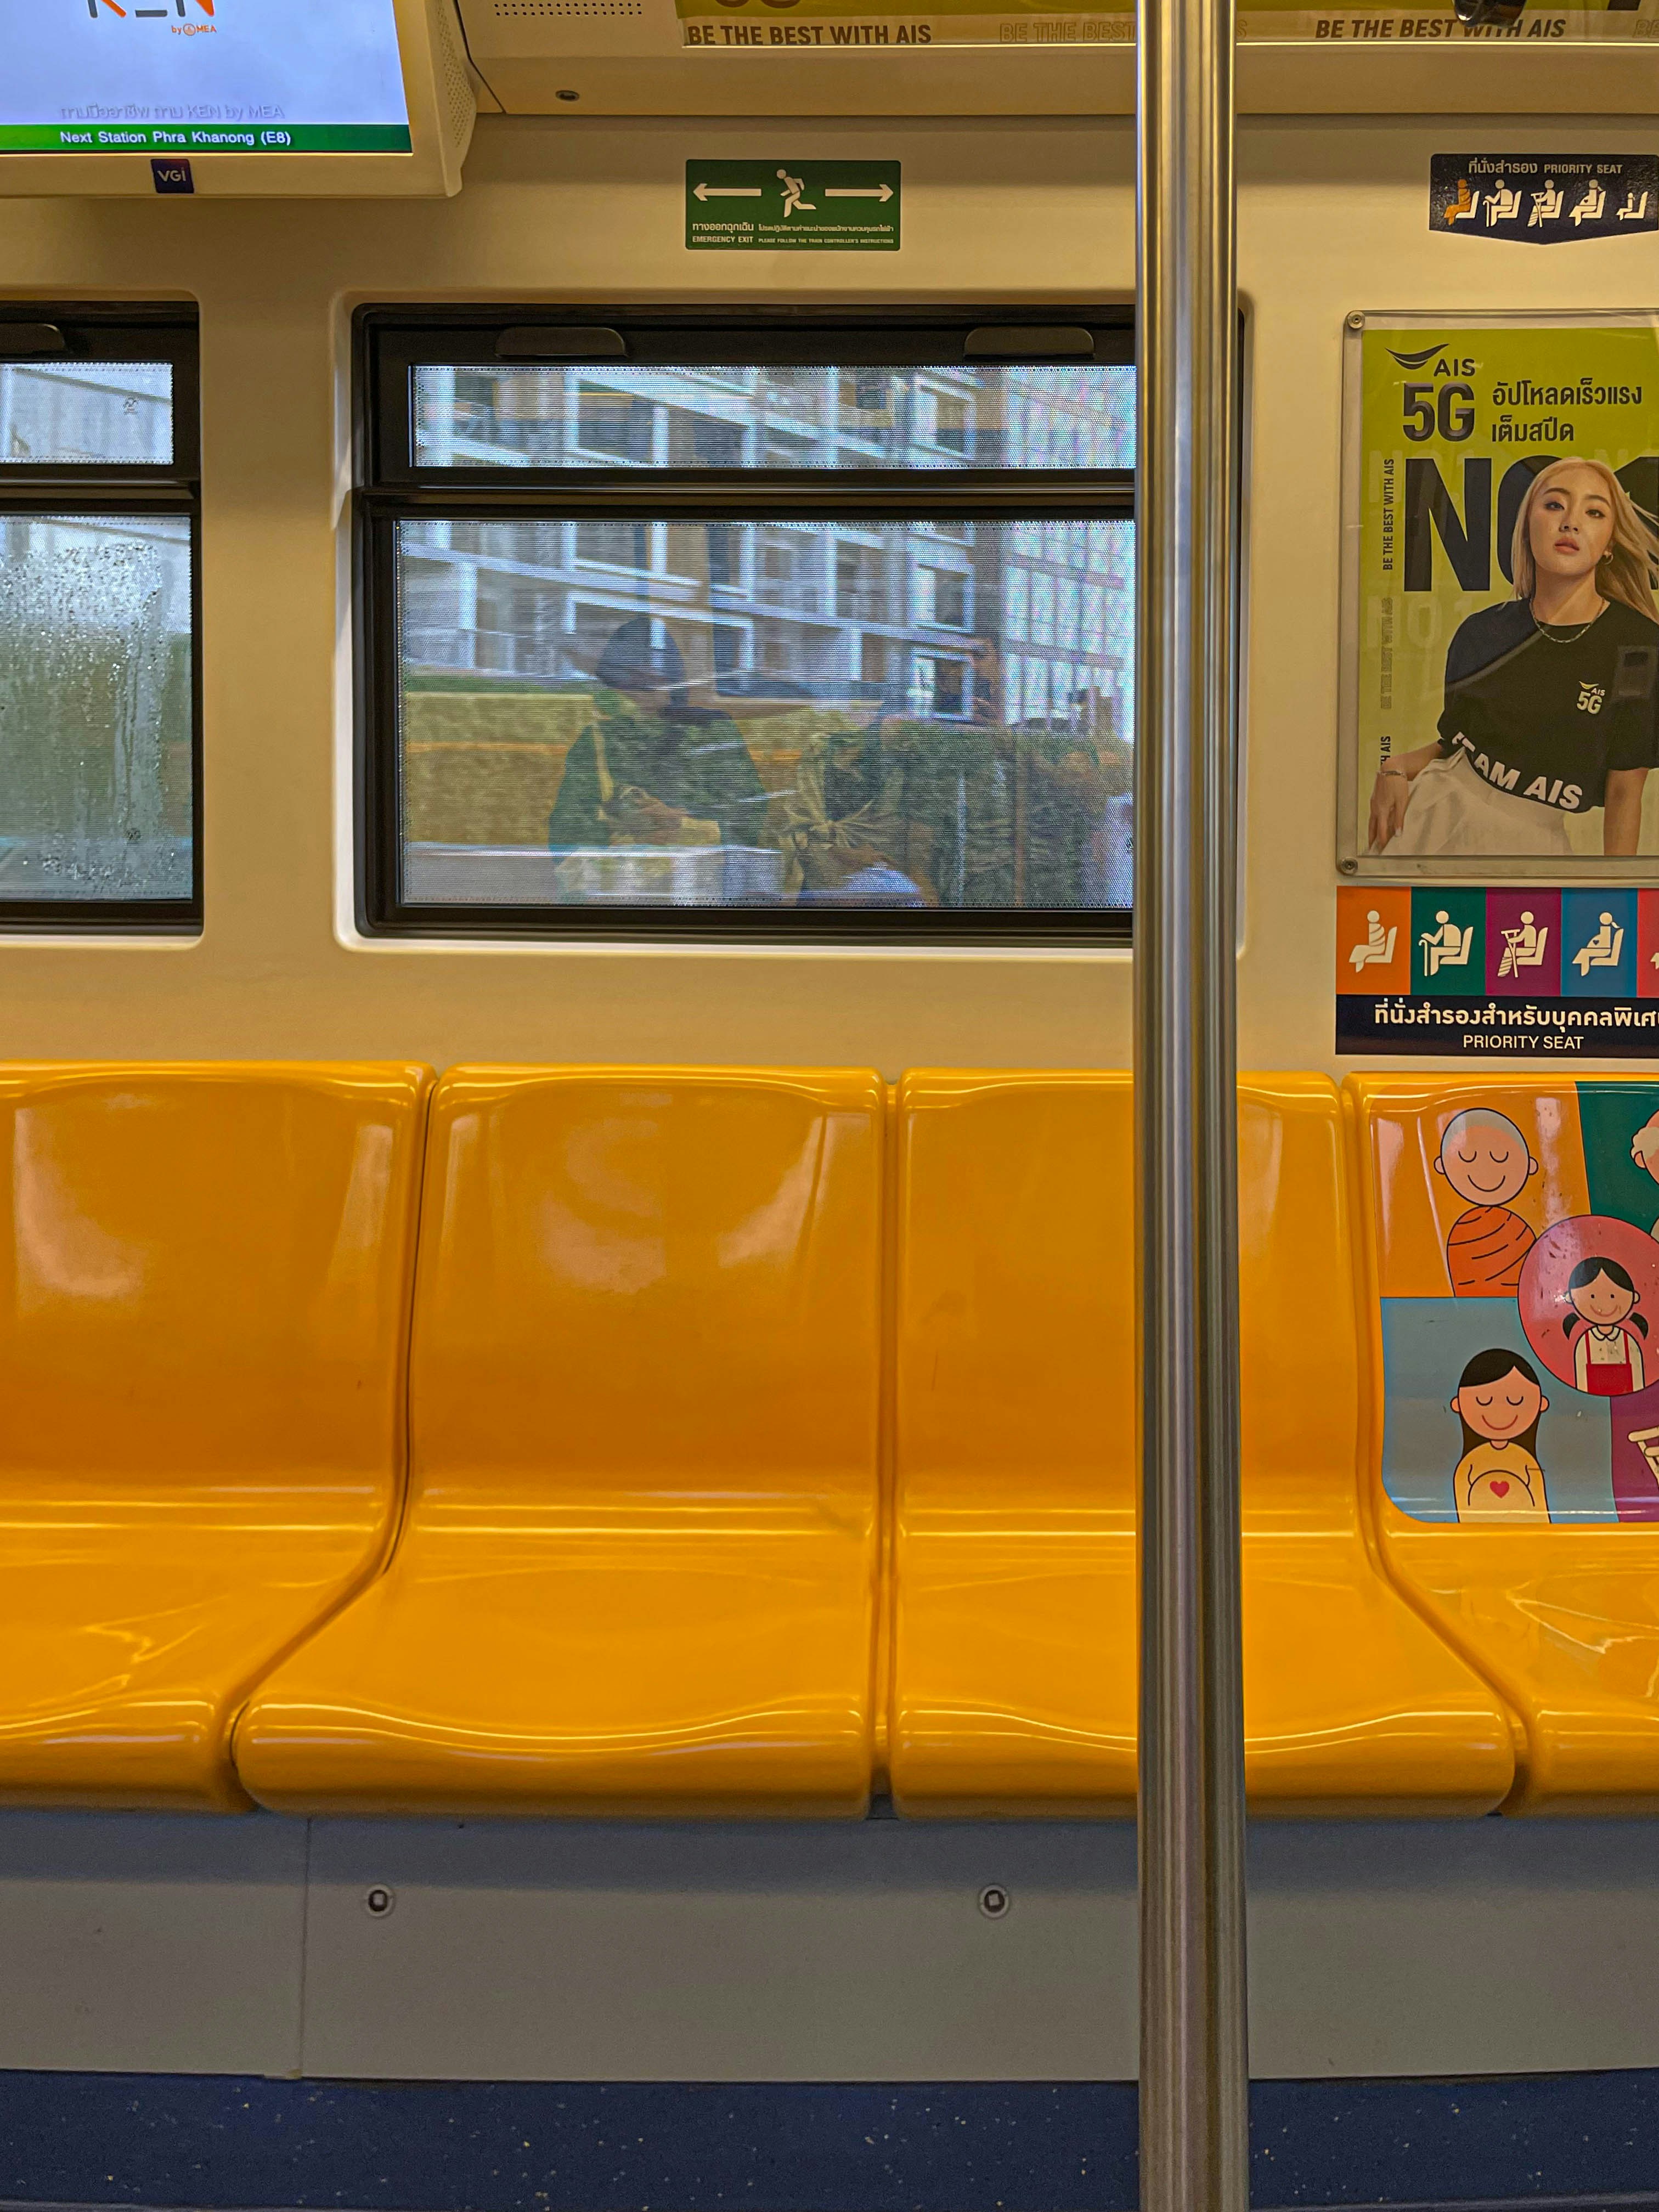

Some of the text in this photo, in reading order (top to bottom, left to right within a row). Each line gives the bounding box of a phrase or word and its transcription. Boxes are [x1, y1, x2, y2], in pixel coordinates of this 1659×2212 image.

[196, 25, 217, 33] MEA
[687, 24, 932, 45] BE THE BEST WITH AIS
[1000, 21, 1136, 43] BE THE BEST
[1315, 19, 1345, 38] BE
[1351, 19, 1394, 38] THE
[1399, 19, 1458, 38] BEST
[1526, 19, 1566, 38] AIS
[249, 105, 285, 119] MEA
[60, 131, 291, 146] Next Station Phra Khanong (E8)
[1468, 157, 1538, 174] ที่นั่งสำรอง
[1544, 164, 1623, 174] PRIORITY SEAT
[692, 222, 754, 234] ทางออกฉุกเฉิน
[1433, 358, 1476, 377] AIS
[1492, 377, 1643, 406] อัปโหลดเร็วแรง
[1402, 382, 1475, 442] 5G
[1491, 415, 1575, 442] เต็มสปีด
[1383, 459, 1395, 571] BE THE BEST WITH AIS
[1590, 687, 1606, 697] AIS
[1576, 691, 1602, 714] 5G
[1380, 736, 1391, 752] AIS
[1523, 776, 1583, 810] AIS
[1374, 997, 1659, 1033] ที่นั่งสำรองสำหรับบุคคลพิเศ
[1463, 1035, 1584, 1049] PRIORITY SEAT
